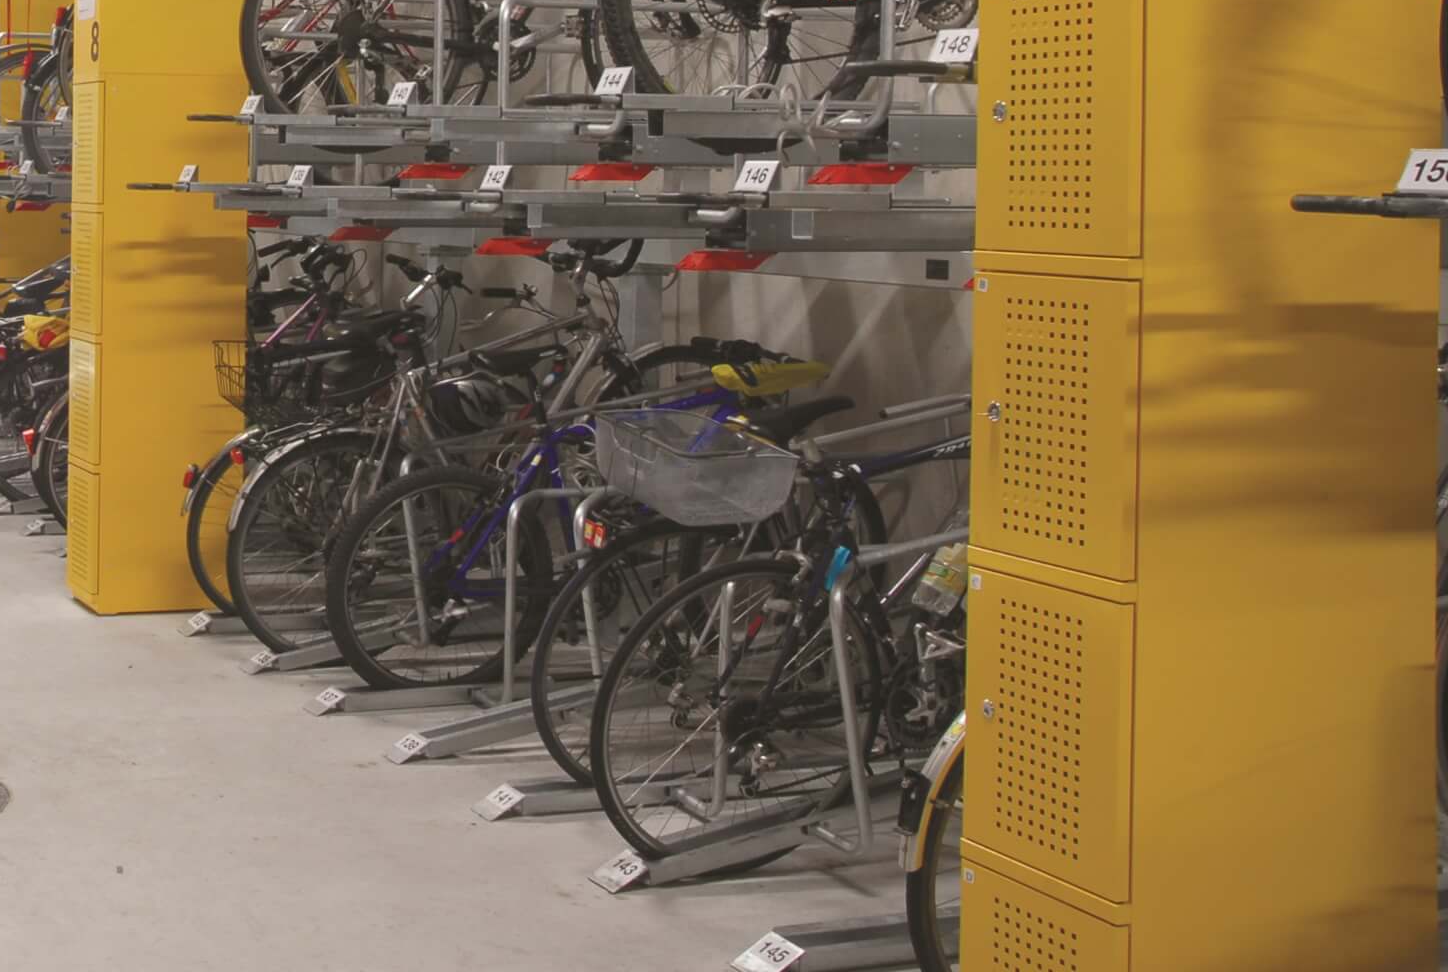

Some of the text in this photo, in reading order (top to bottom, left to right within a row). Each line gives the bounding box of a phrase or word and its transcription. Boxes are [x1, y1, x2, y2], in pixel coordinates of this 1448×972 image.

[90, 21, 99, 62] 8
[937, 35, 971, 54] 148
[603, 73, 623, 89] 144
[487, 170, 505, 185] 142
[744, 167, 769, 184] 146
[1413, 159, 1448, 183] 15
[493, 790, 514, 805] 141
[612, 858, 638, 876] 143
[759, 941, 790, 963] 145
